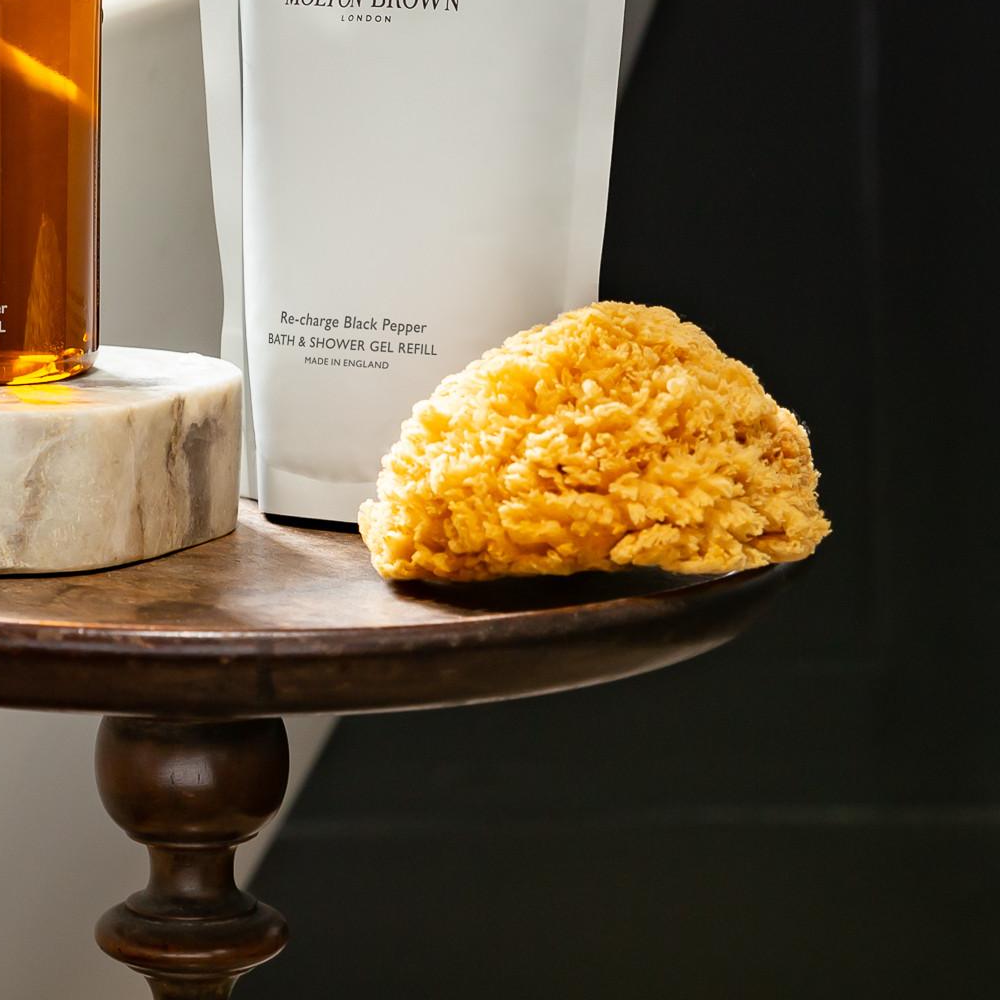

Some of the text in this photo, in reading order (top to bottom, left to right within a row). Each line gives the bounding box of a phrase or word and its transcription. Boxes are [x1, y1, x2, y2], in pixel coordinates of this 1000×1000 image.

[341, 14, 392, 23] LONDON
[280, 311, 428, 336] Re-charge Black Pepper
[268, 333, 438, 356] BATH & SHOWER GEL REFILL
[304, 356, 389, 370] MADE IN ENGLAND
